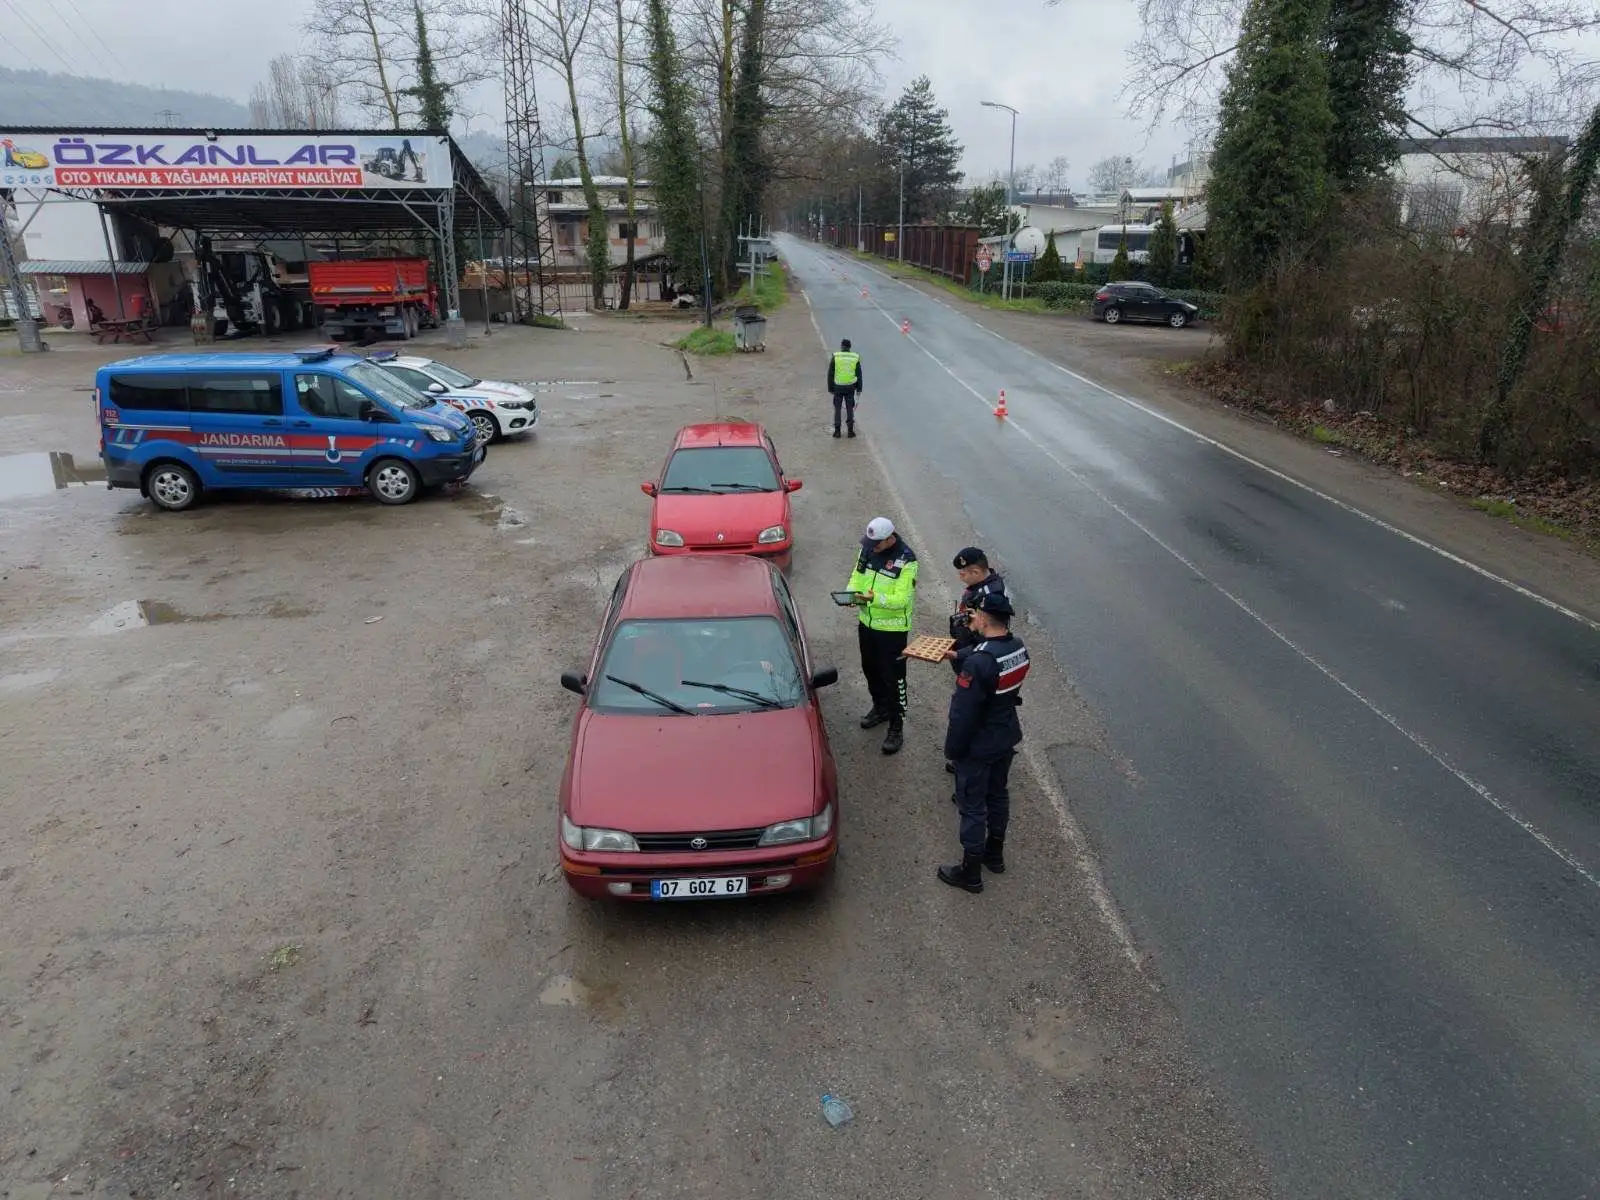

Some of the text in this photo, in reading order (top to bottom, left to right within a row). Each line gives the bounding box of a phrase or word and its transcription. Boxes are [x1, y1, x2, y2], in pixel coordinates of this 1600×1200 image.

[53, 138, 356, 165] ÖZKANLAR
[60, 168, 358, 185] OTO YIKAMA & YAĞLAMA HAFRİYAT NAKLİYAT
[200, 433, 285, 447] JANDARMA
[661, 879, 744, 895] 07 GOZ 67
